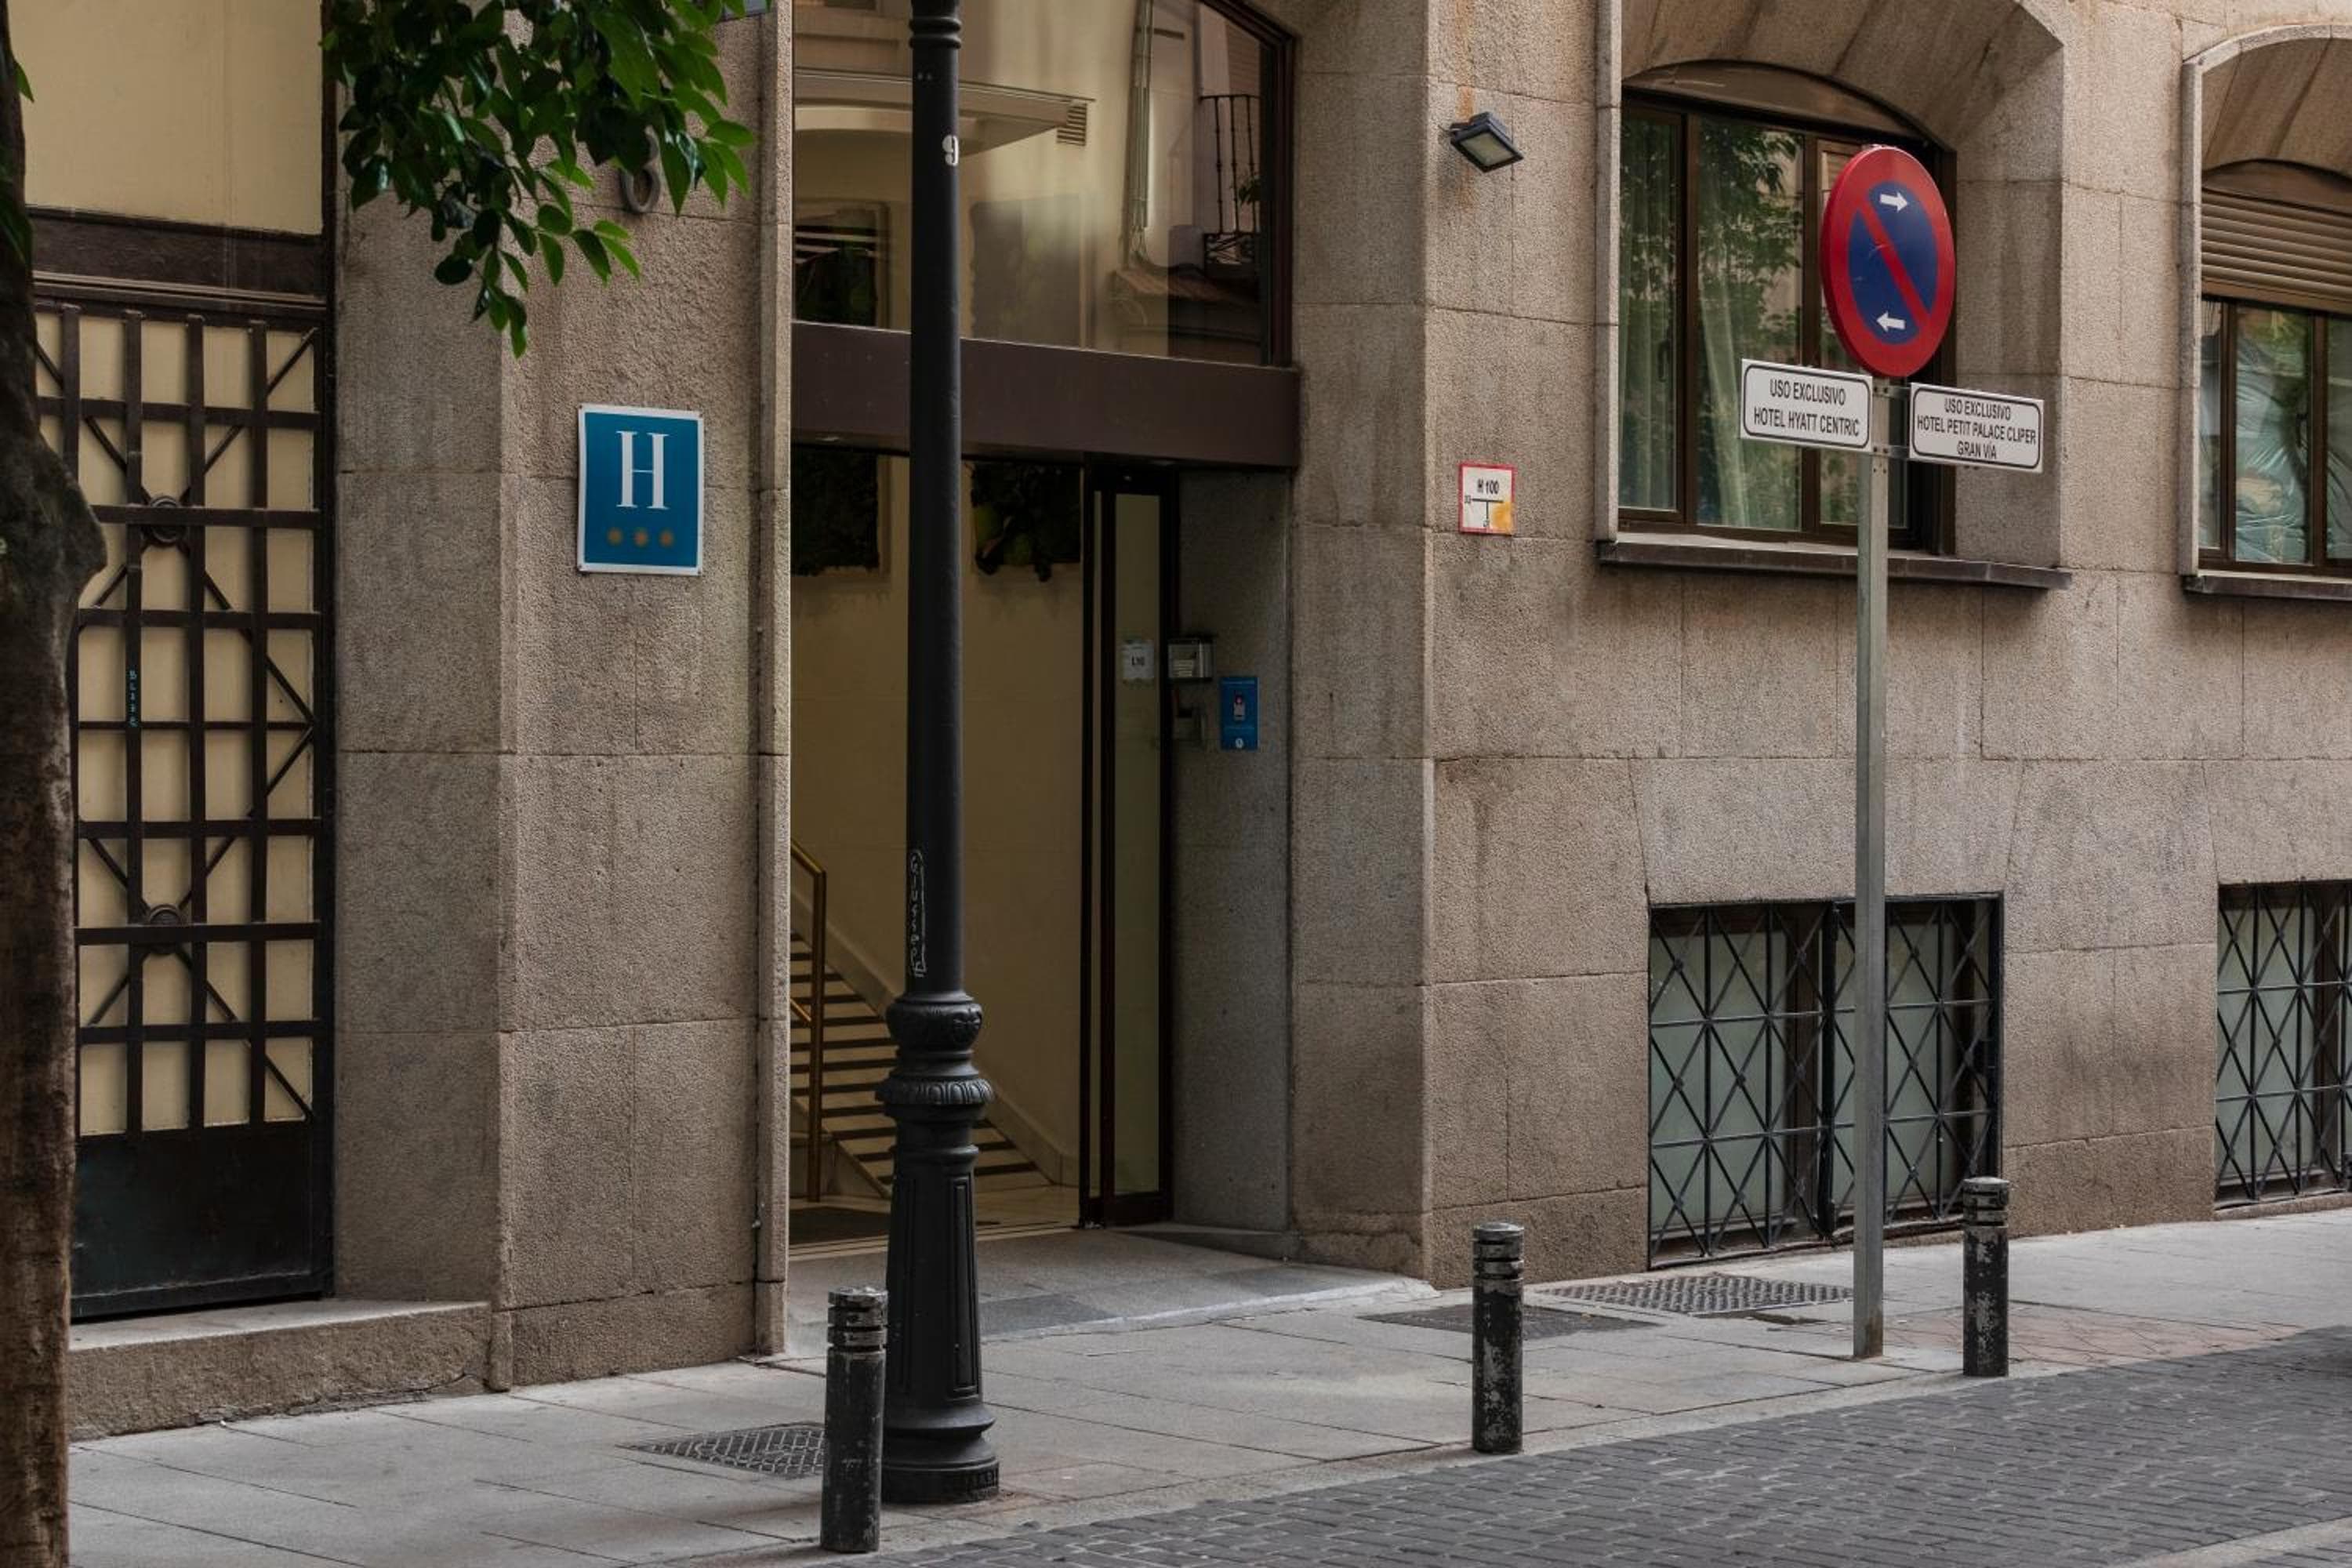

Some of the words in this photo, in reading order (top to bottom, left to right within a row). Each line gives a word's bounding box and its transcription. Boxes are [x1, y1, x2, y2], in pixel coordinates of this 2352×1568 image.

[1769, 379, 1791, 399] USO
[1793, 382, 1846, 405] EXCLUSIVO
[1754, 406, 1786, 427] HOTEL
[1788, 410, 1818, 431] HYATT
[1820, 415, 1860, 437] CENTRIC
[1944, 397, 1962, 414] USO
[1965, 401, 2011, 421] EXCLUSIVO
[1917, 414, 1945, 432] HOTEL
[1947, 419, 1971, 436] PETIT
[1972, 422, 2005, 441] PALACE
[2006, 426, 2036, 445] CLIPER
[1957, 441, 1981, 458] GRAN
[615, 430, 670, 510] H
[1486, 479, 1500, 495] 100
